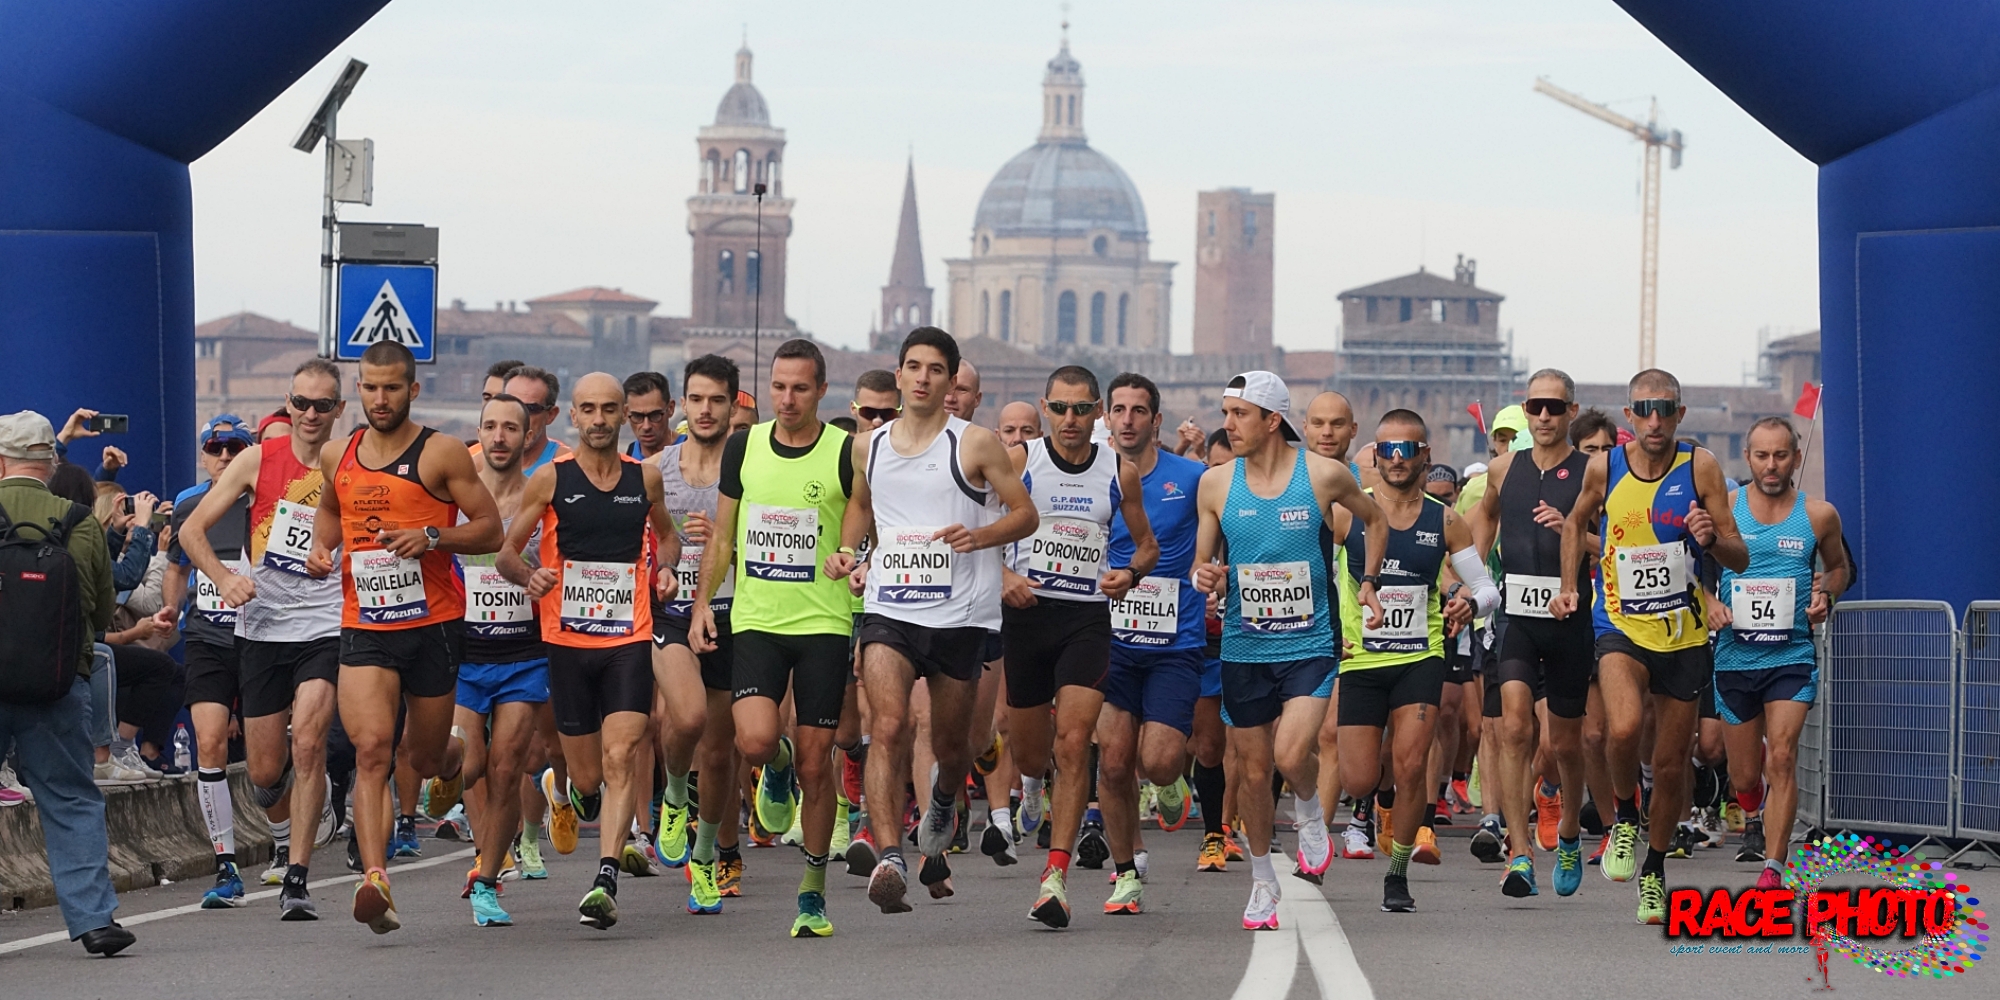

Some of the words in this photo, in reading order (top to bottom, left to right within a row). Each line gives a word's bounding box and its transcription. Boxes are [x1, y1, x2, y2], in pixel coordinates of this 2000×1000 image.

[1053, 503, 1091, 512] SUZZARA
[1279, 510, 1310, 522] AVIS
[285, 526, 312, 552] 52
[746, 530, 816, 549] MONTORIO
[1777, 540, 1805, 550] AVIS
[787, 554, 794, 563] 5
[1032, 538, 1101, 563] D'ORONZIO
[883, 553, 949, 569] ORLANDI
[1072, 565, 1079, 575] 9
[1632, 566, 1671, 589] 253
[356, 571, 422, 592] ANGILELLA
[919, 574, 932, 584] 10
[396, 593, 404, 603] 6
[473, 591, 524, 607] TOSINI
[564, 585, 632, 605] MAROGNA
[1242, 585, 1310, 603] CORRADI
[1520, 587, 1552, 607] 419
[507, 611, 514, 620] 7
[606, 608, 613, 618] 8
[1111, 599, 1176, 618] PETRELLA
[1282, 606, 1294, 616] 14
[1751, 600, 1775, 620] 54
[1147, 620, 1158, 630] 17
